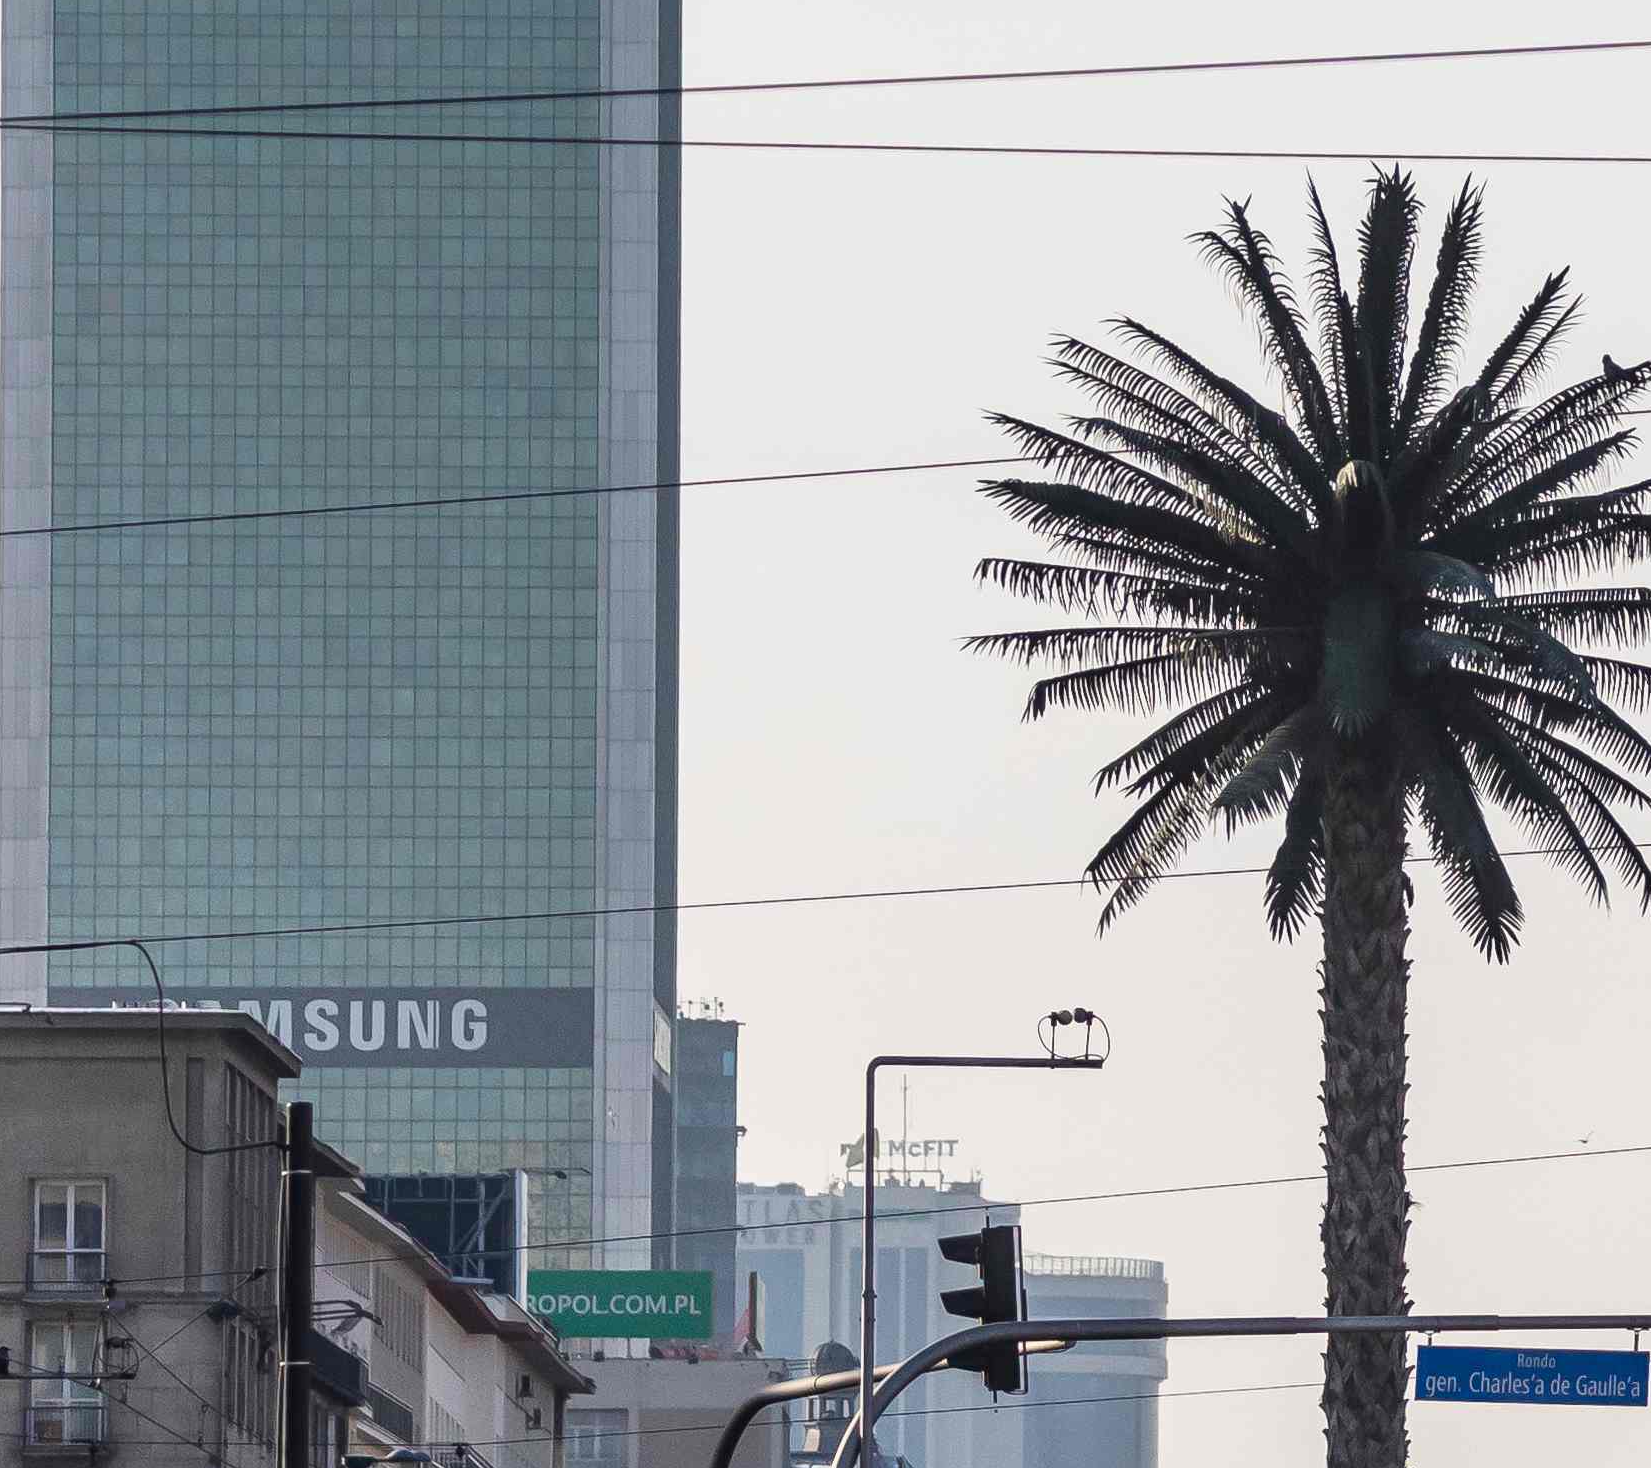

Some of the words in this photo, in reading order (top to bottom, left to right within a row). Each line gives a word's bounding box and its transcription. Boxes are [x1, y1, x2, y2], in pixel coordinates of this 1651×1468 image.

[149, 998, 488, 1052] MSUNG
[742, 1199, 824, 1222] TLAS
[526, 1293, 702, 1318] ROPOL.COM.PL
[1517, 1353, 1556, 1369] Rondo
[1425, 1374, 1461, 1397] gen.
[1469, 1371, 1544, 1395] Charles'a
[1551, 1373, 1570, 1395] de
[1575, 1375, 1641, 1398] Gaulle'a
